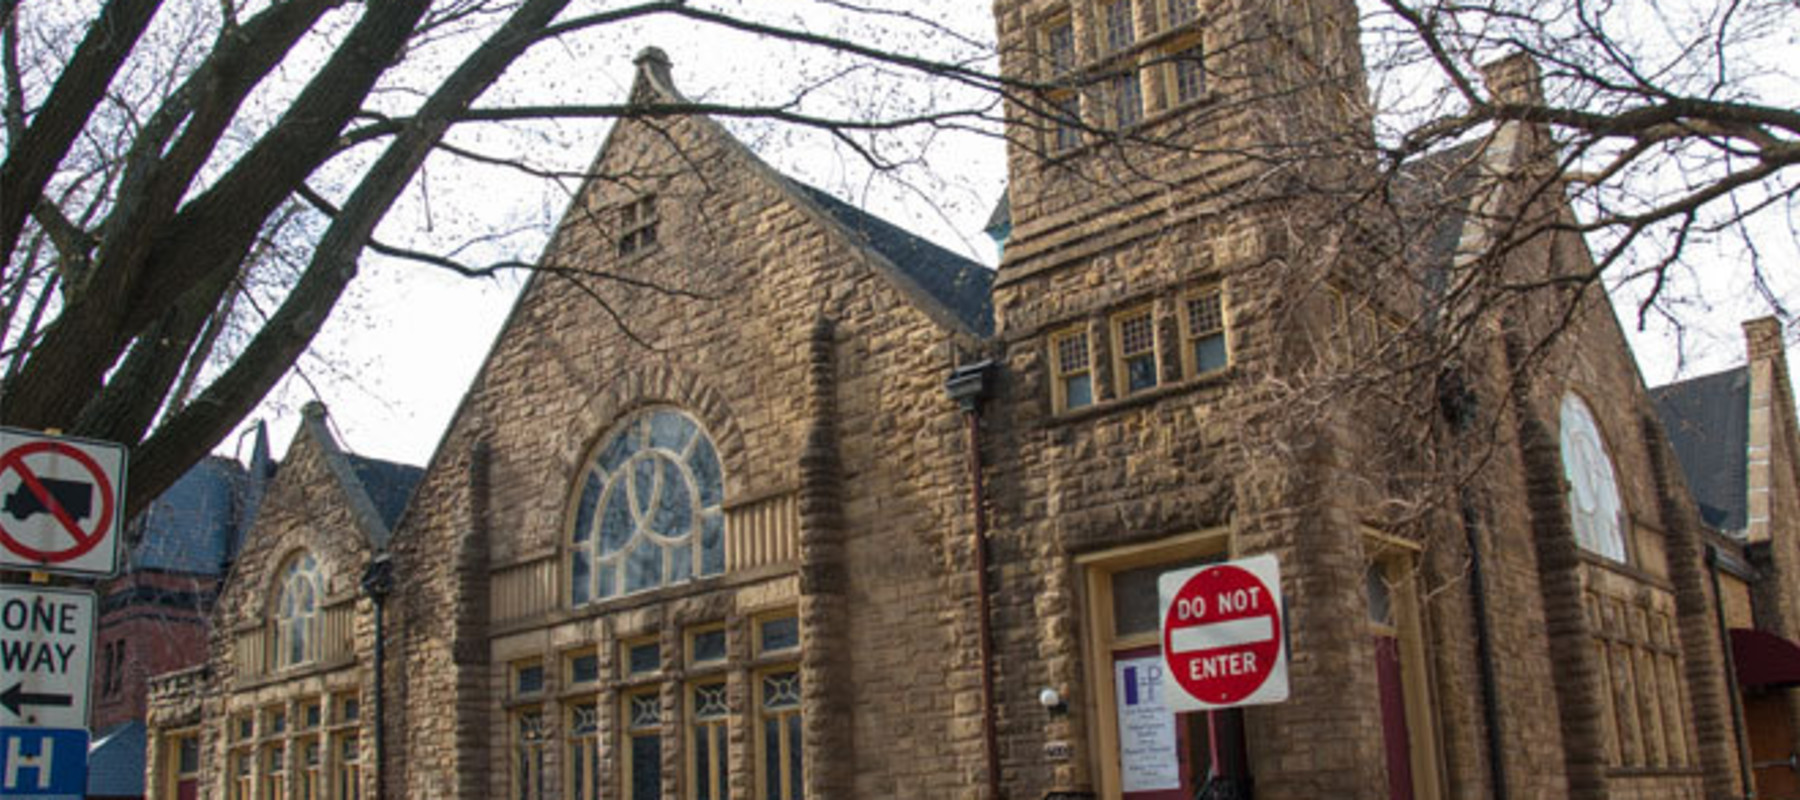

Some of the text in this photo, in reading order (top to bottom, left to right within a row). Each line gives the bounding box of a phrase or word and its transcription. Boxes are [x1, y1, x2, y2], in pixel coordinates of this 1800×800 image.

[2, 597, 78, 634] ONE
[1178, 586, 1260, 620] DO NOT
[1, 638, 76, 674] WAY
[1189, 652, 1257, 680] ENTER
[3, 736, 54, 790] H
